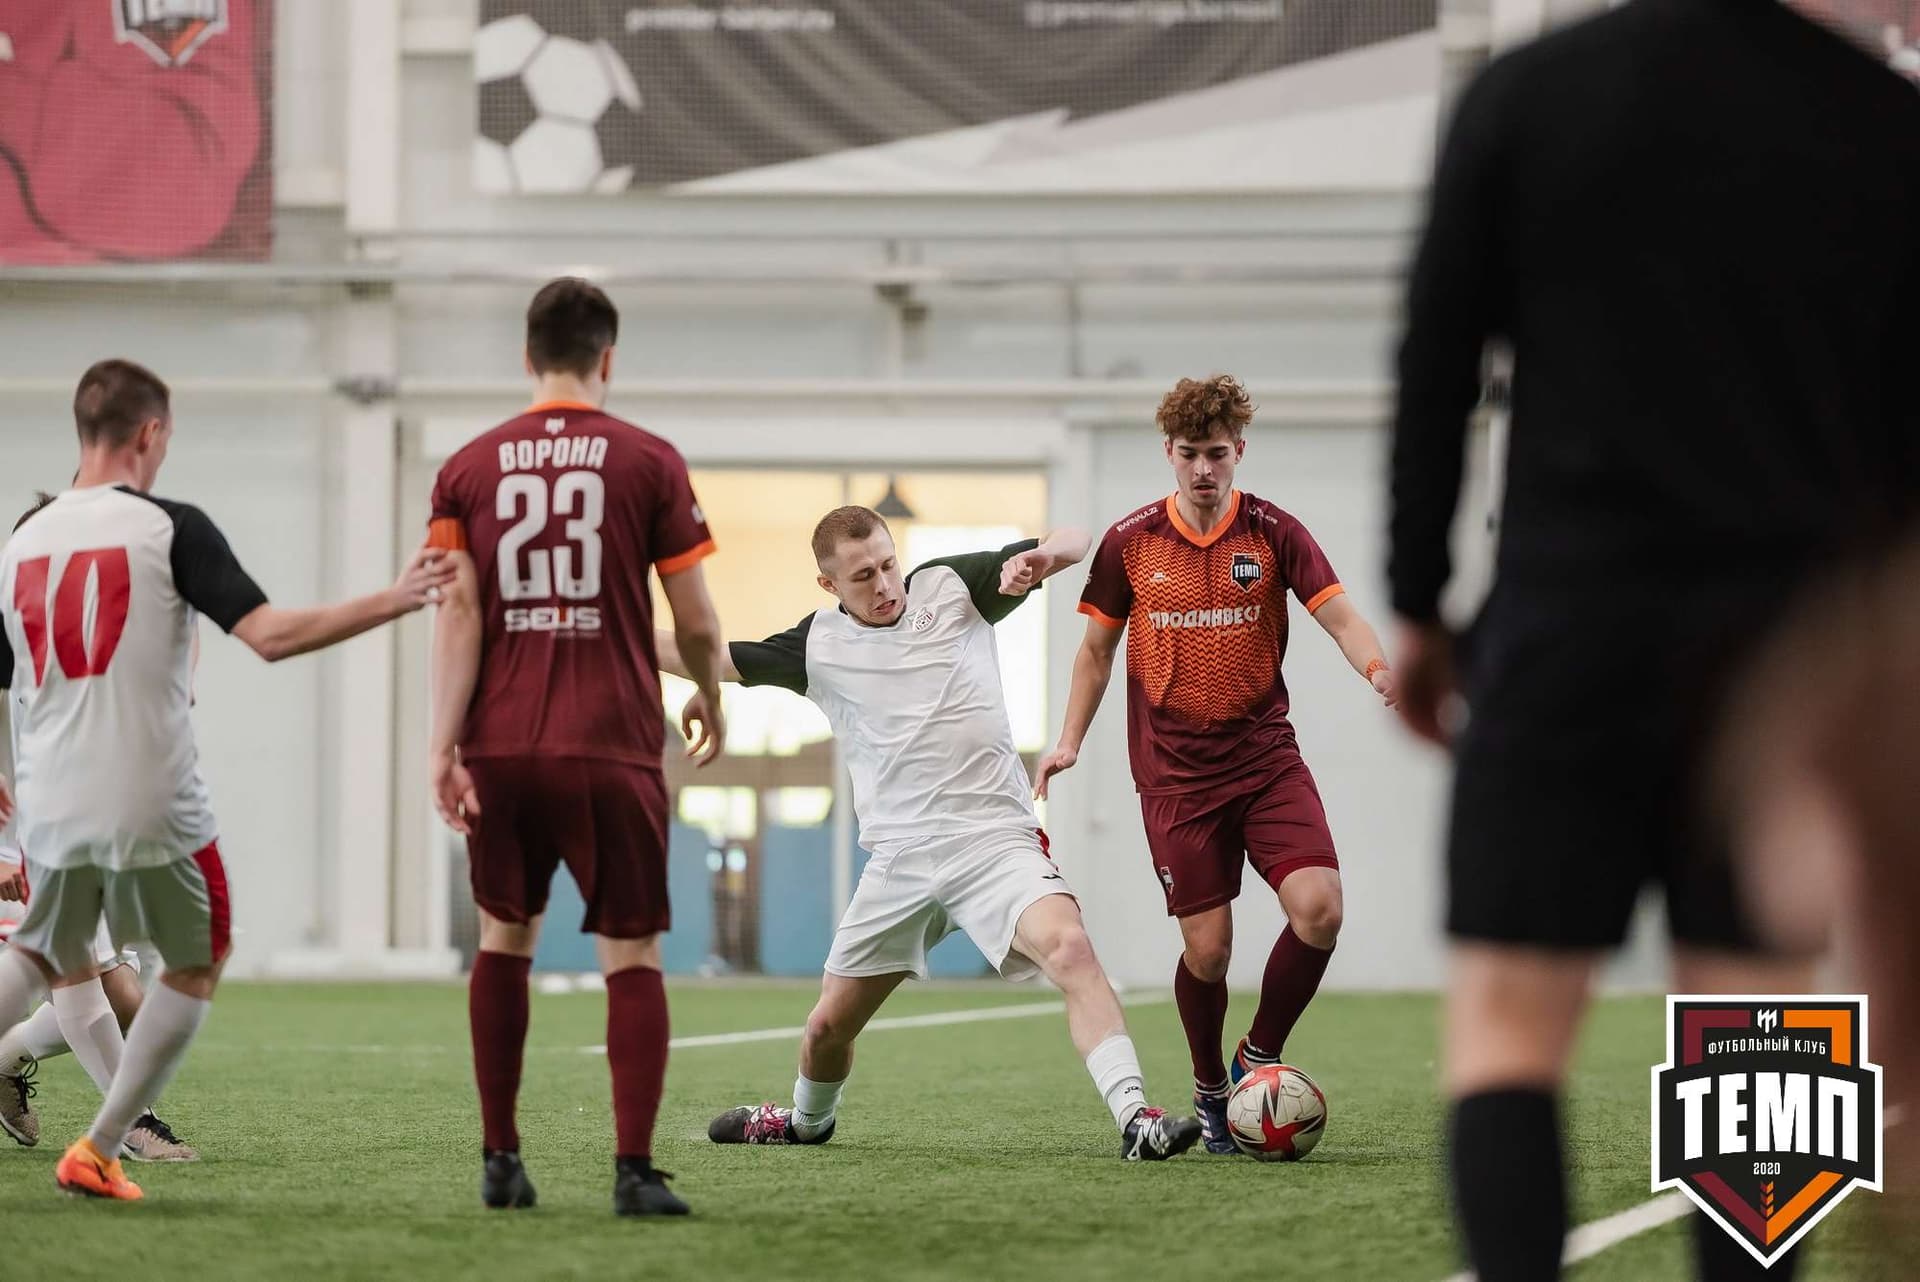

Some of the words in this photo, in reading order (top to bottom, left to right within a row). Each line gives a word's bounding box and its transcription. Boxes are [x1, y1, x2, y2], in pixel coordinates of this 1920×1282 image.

[499, 436, 608, 473] ВОРОНА
[496, 470, 605, 600] 23
[1233, 563, 1259, 578] ТЕМП
[14, 546, 130, 689] 10
[504, 606, 601, 632] SEUS
[1148, 604, 1261, 630] ПРОДИНВЕСТ
